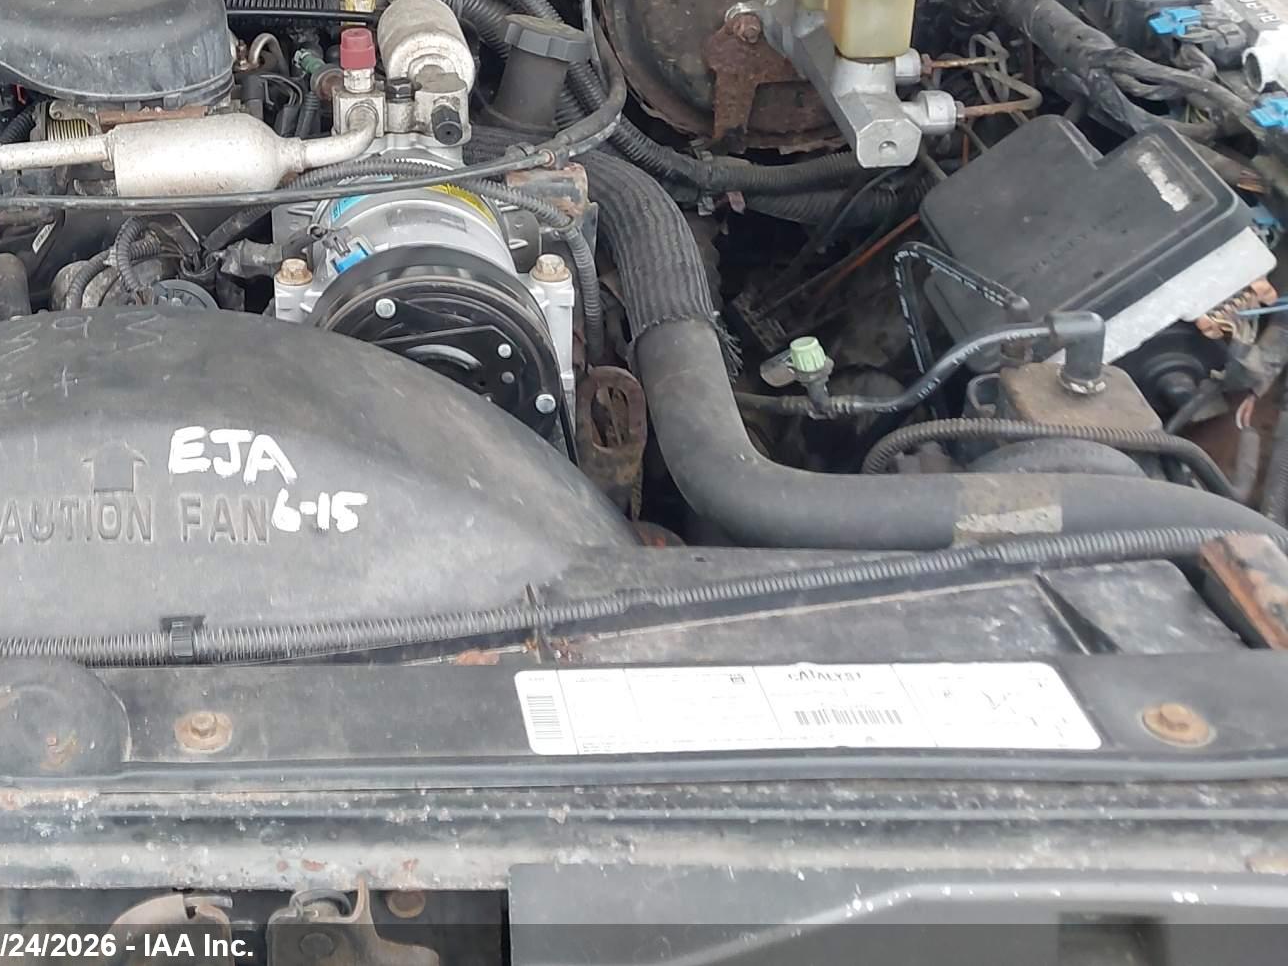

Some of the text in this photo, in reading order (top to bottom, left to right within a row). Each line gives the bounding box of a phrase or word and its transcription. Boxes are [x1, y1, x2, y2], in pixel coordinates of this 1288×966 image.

[168, 425, 298, 485] EJA
[178, 492, 271, 545] FAN
[270, 488, 369, 533] 6-15
